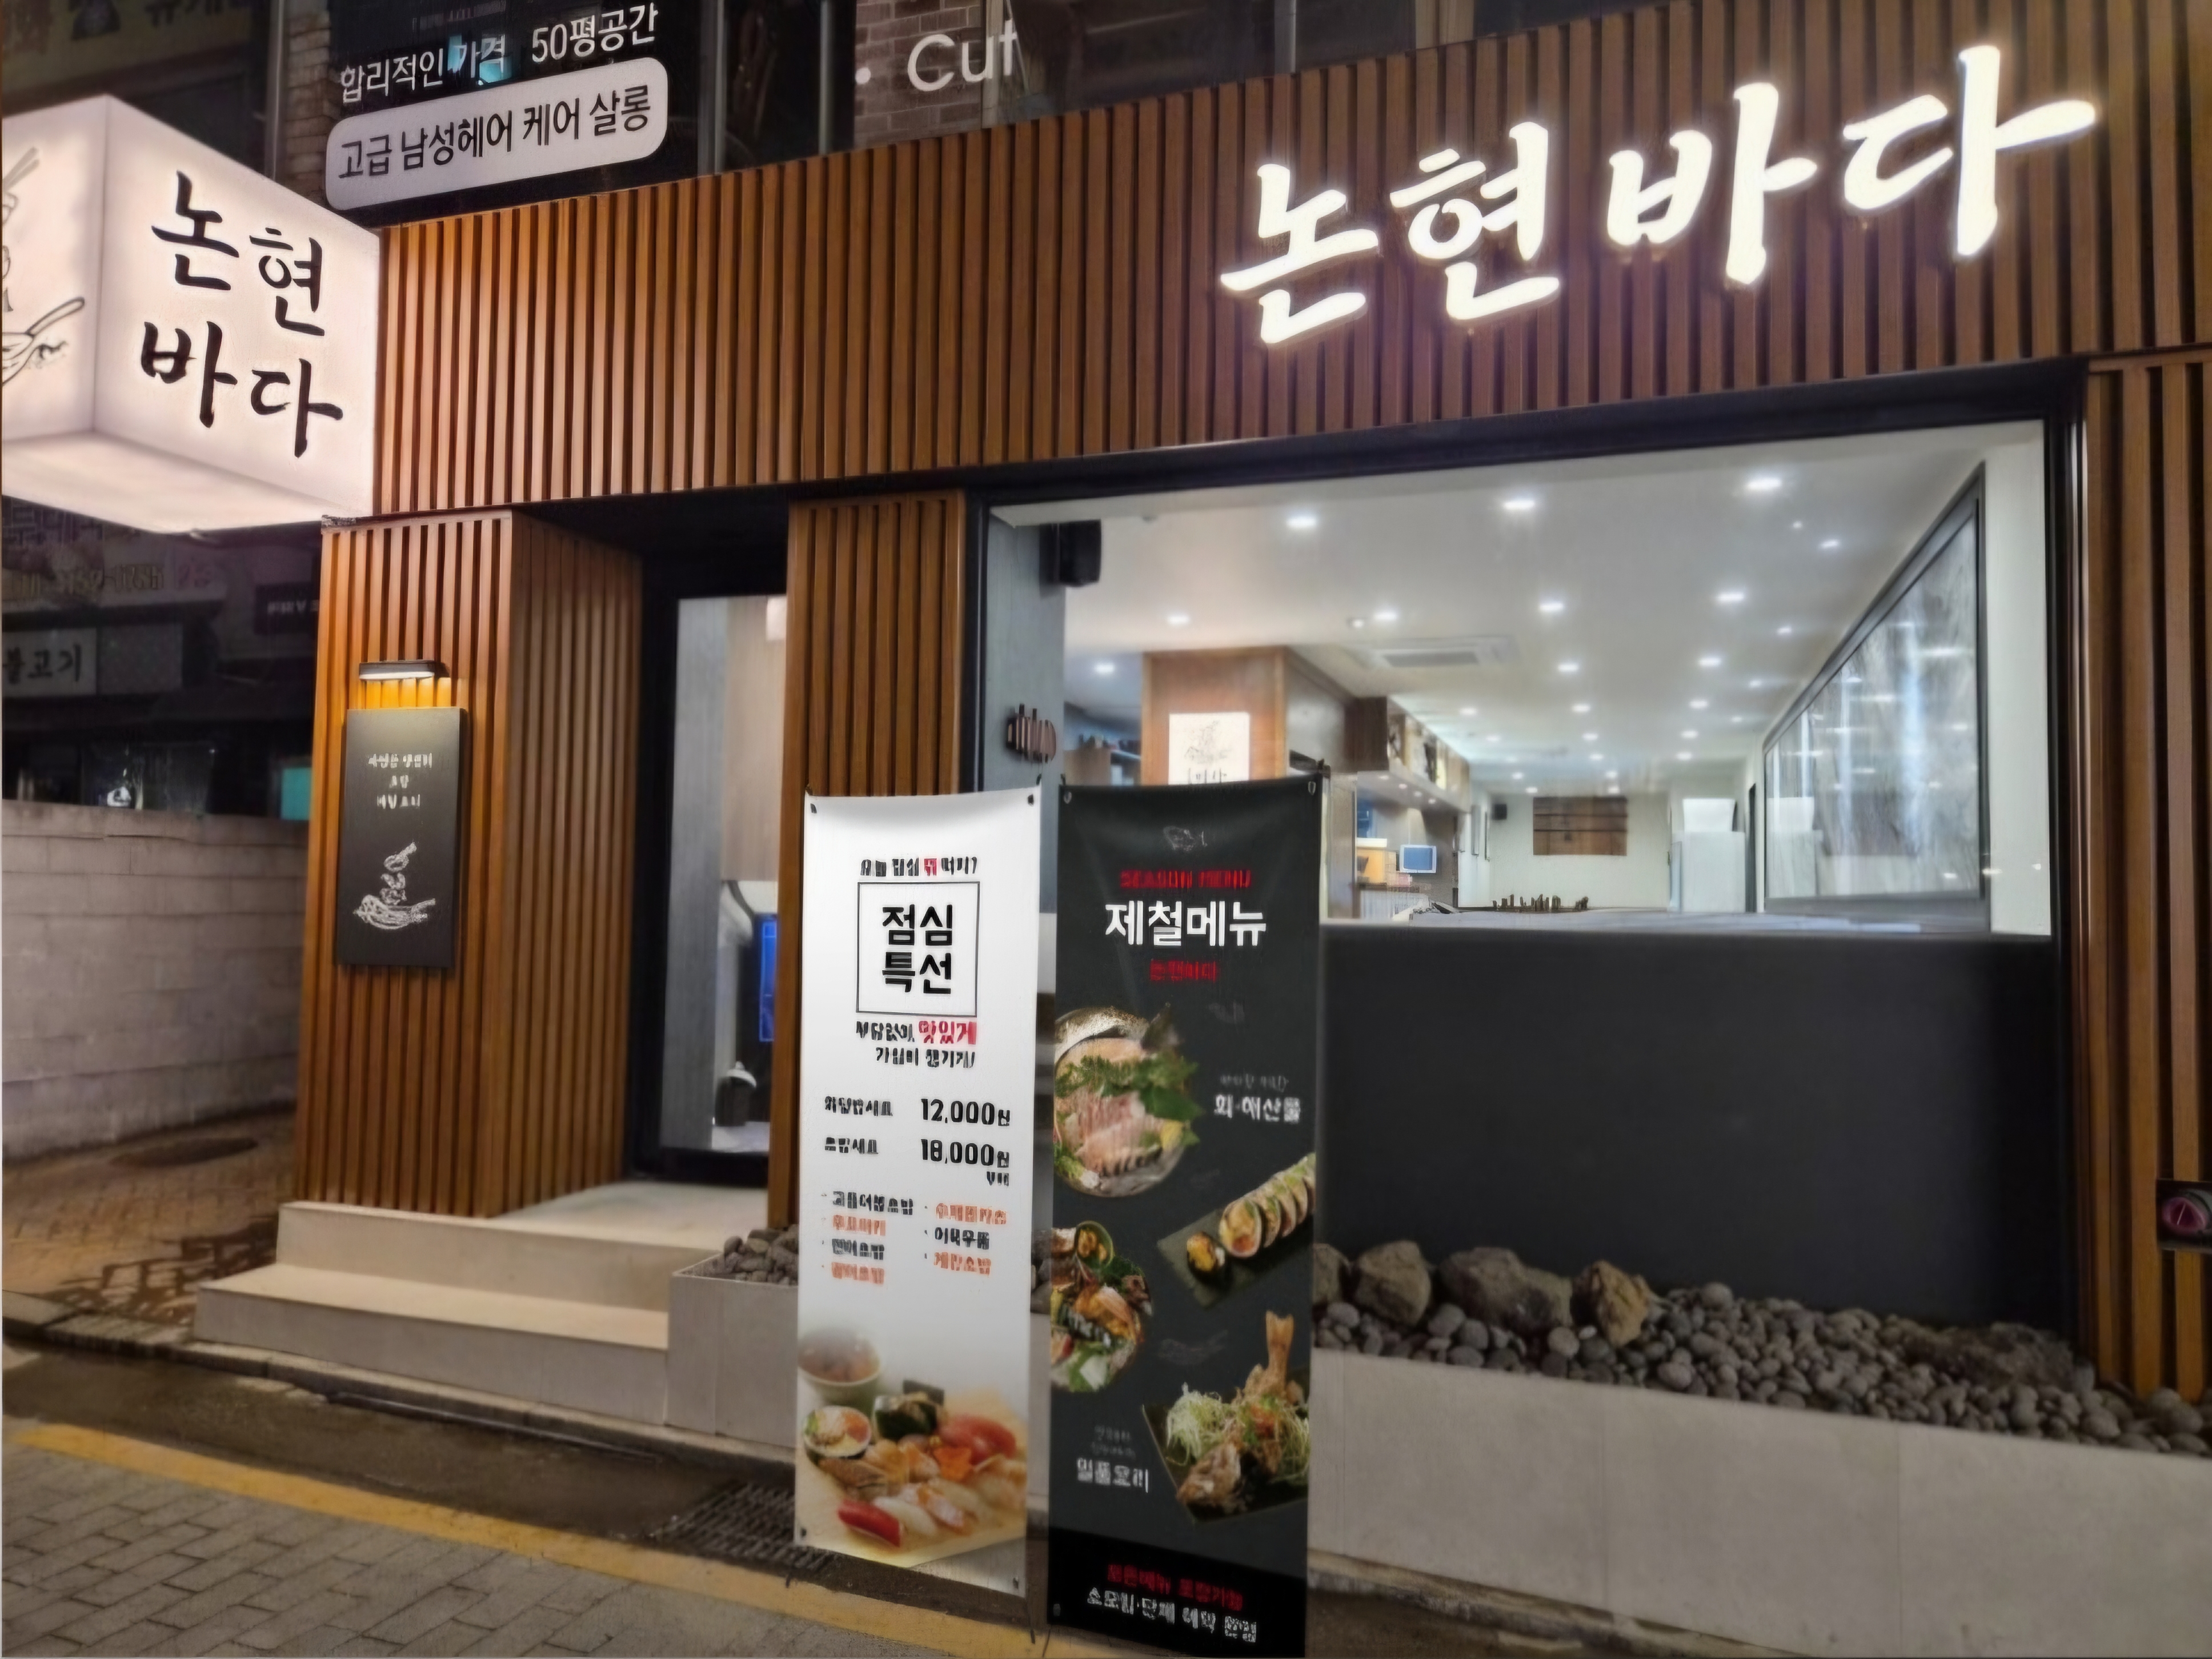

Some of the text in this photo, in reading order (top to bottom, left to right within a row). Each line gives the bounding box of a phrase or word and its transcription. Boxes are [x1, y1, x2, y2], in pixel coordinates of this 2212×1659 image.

[341, 2, 658, 103] 합리적인 가격 50평공간
[339, 85, 651, 178] 고급 남성헤어 케어 살롱
[1220, 45, 2097, 344] 논현바다
[151, 170, 325, 337] 논현
[141, 320, 344, 459] 바다
[882, 904, 953, 946] 점심
[1105, 900, 1267, 947] 제철메뉴
[881, 952, 952, 995] 특선
